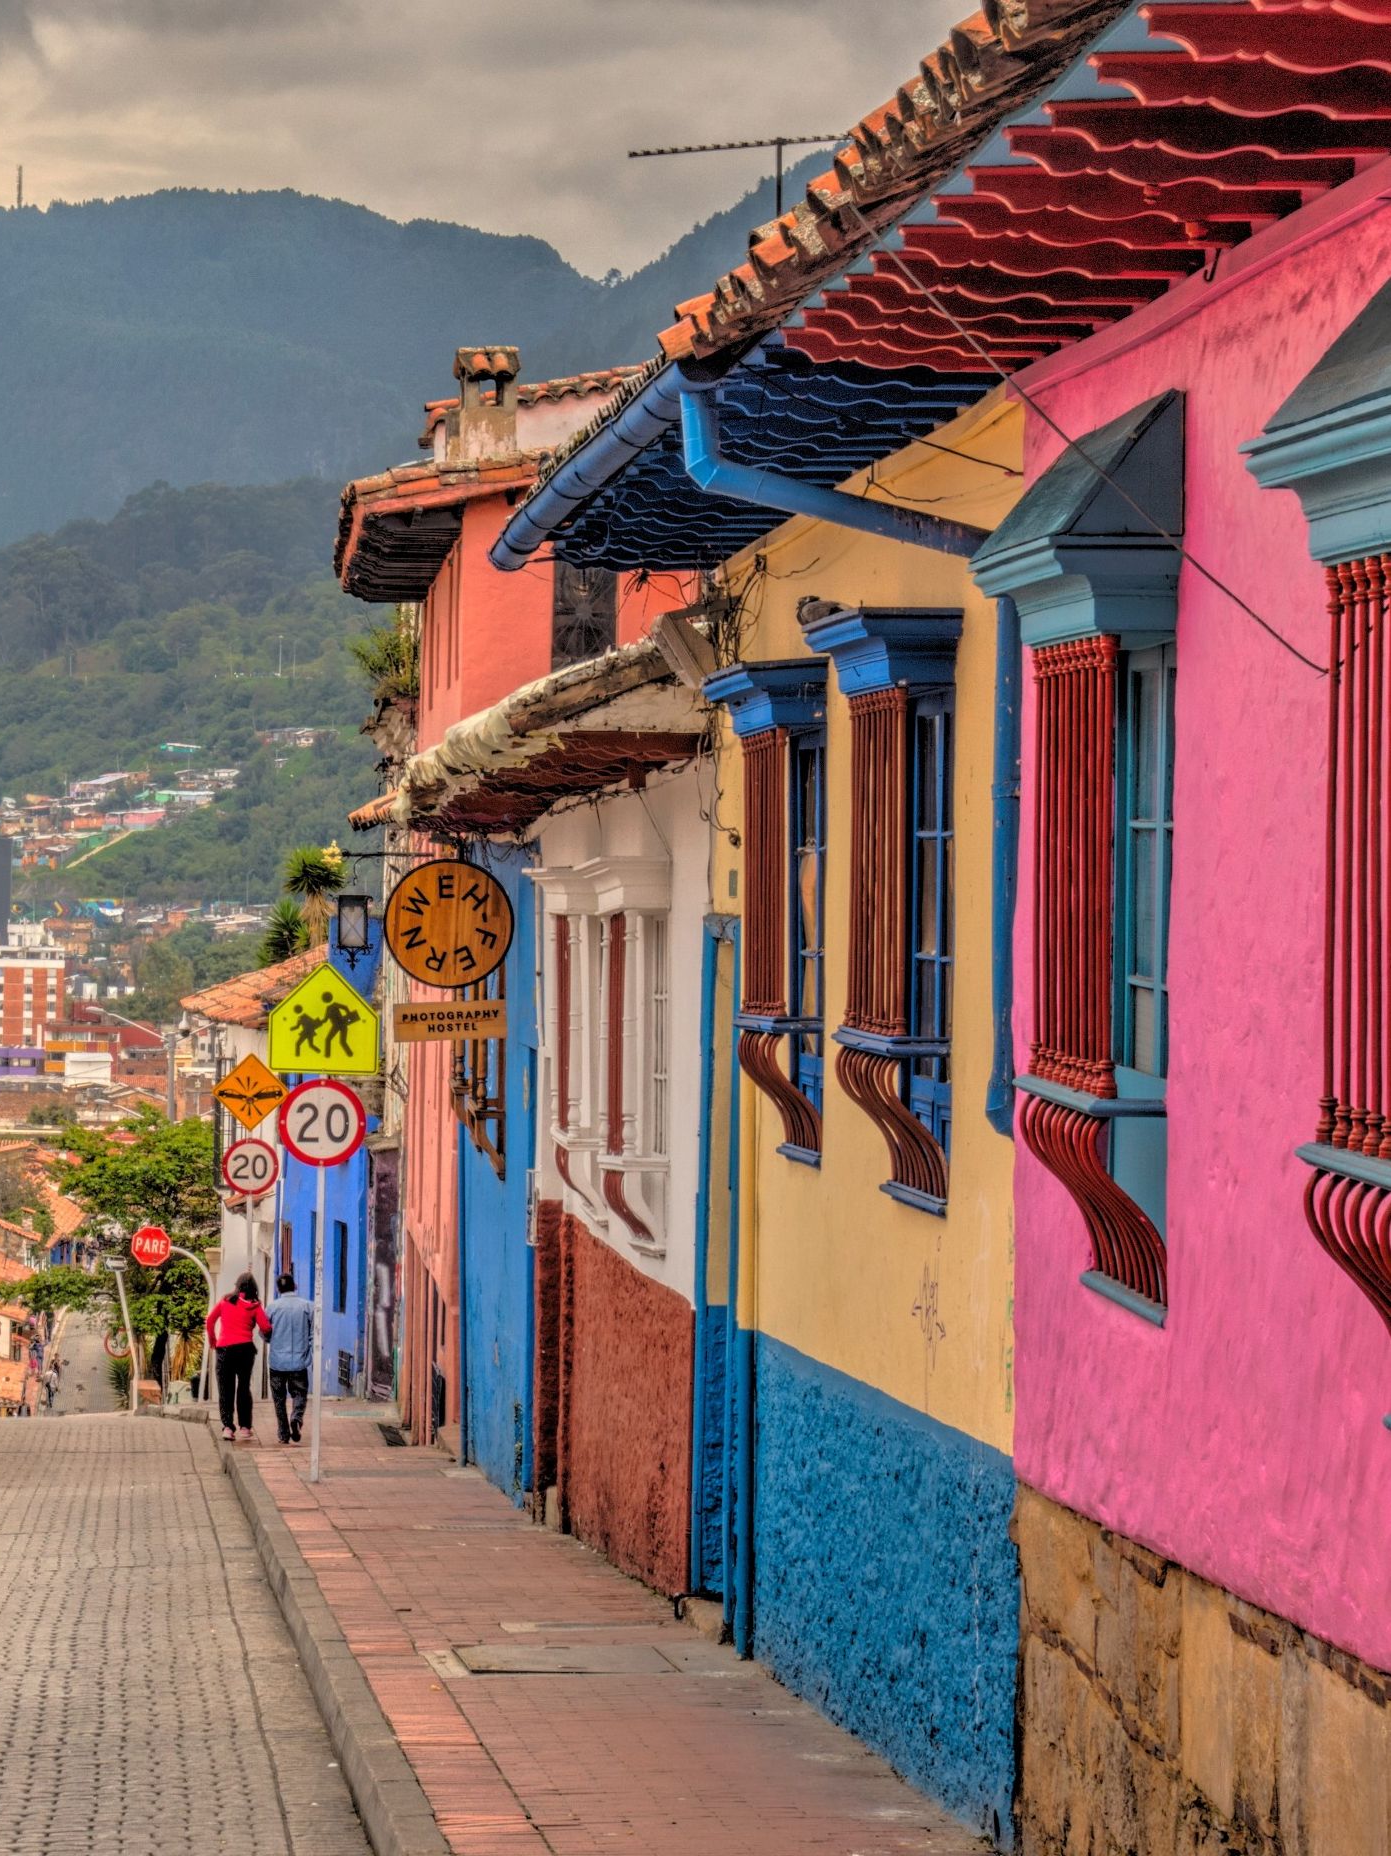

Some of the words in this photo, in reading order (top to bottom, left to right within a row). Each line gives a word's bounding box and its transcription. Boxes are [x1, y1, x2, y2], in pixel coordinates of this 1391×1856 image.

[402, 1009, 499, 1022] PHOTOGRAPHY
[428, 1022, 478, 1033] HOSTEL
[296, 1103, 350, 1143] 20
[232, 1154, 268, 1180] 20
[135, 1237, 167, 1255] PARE
